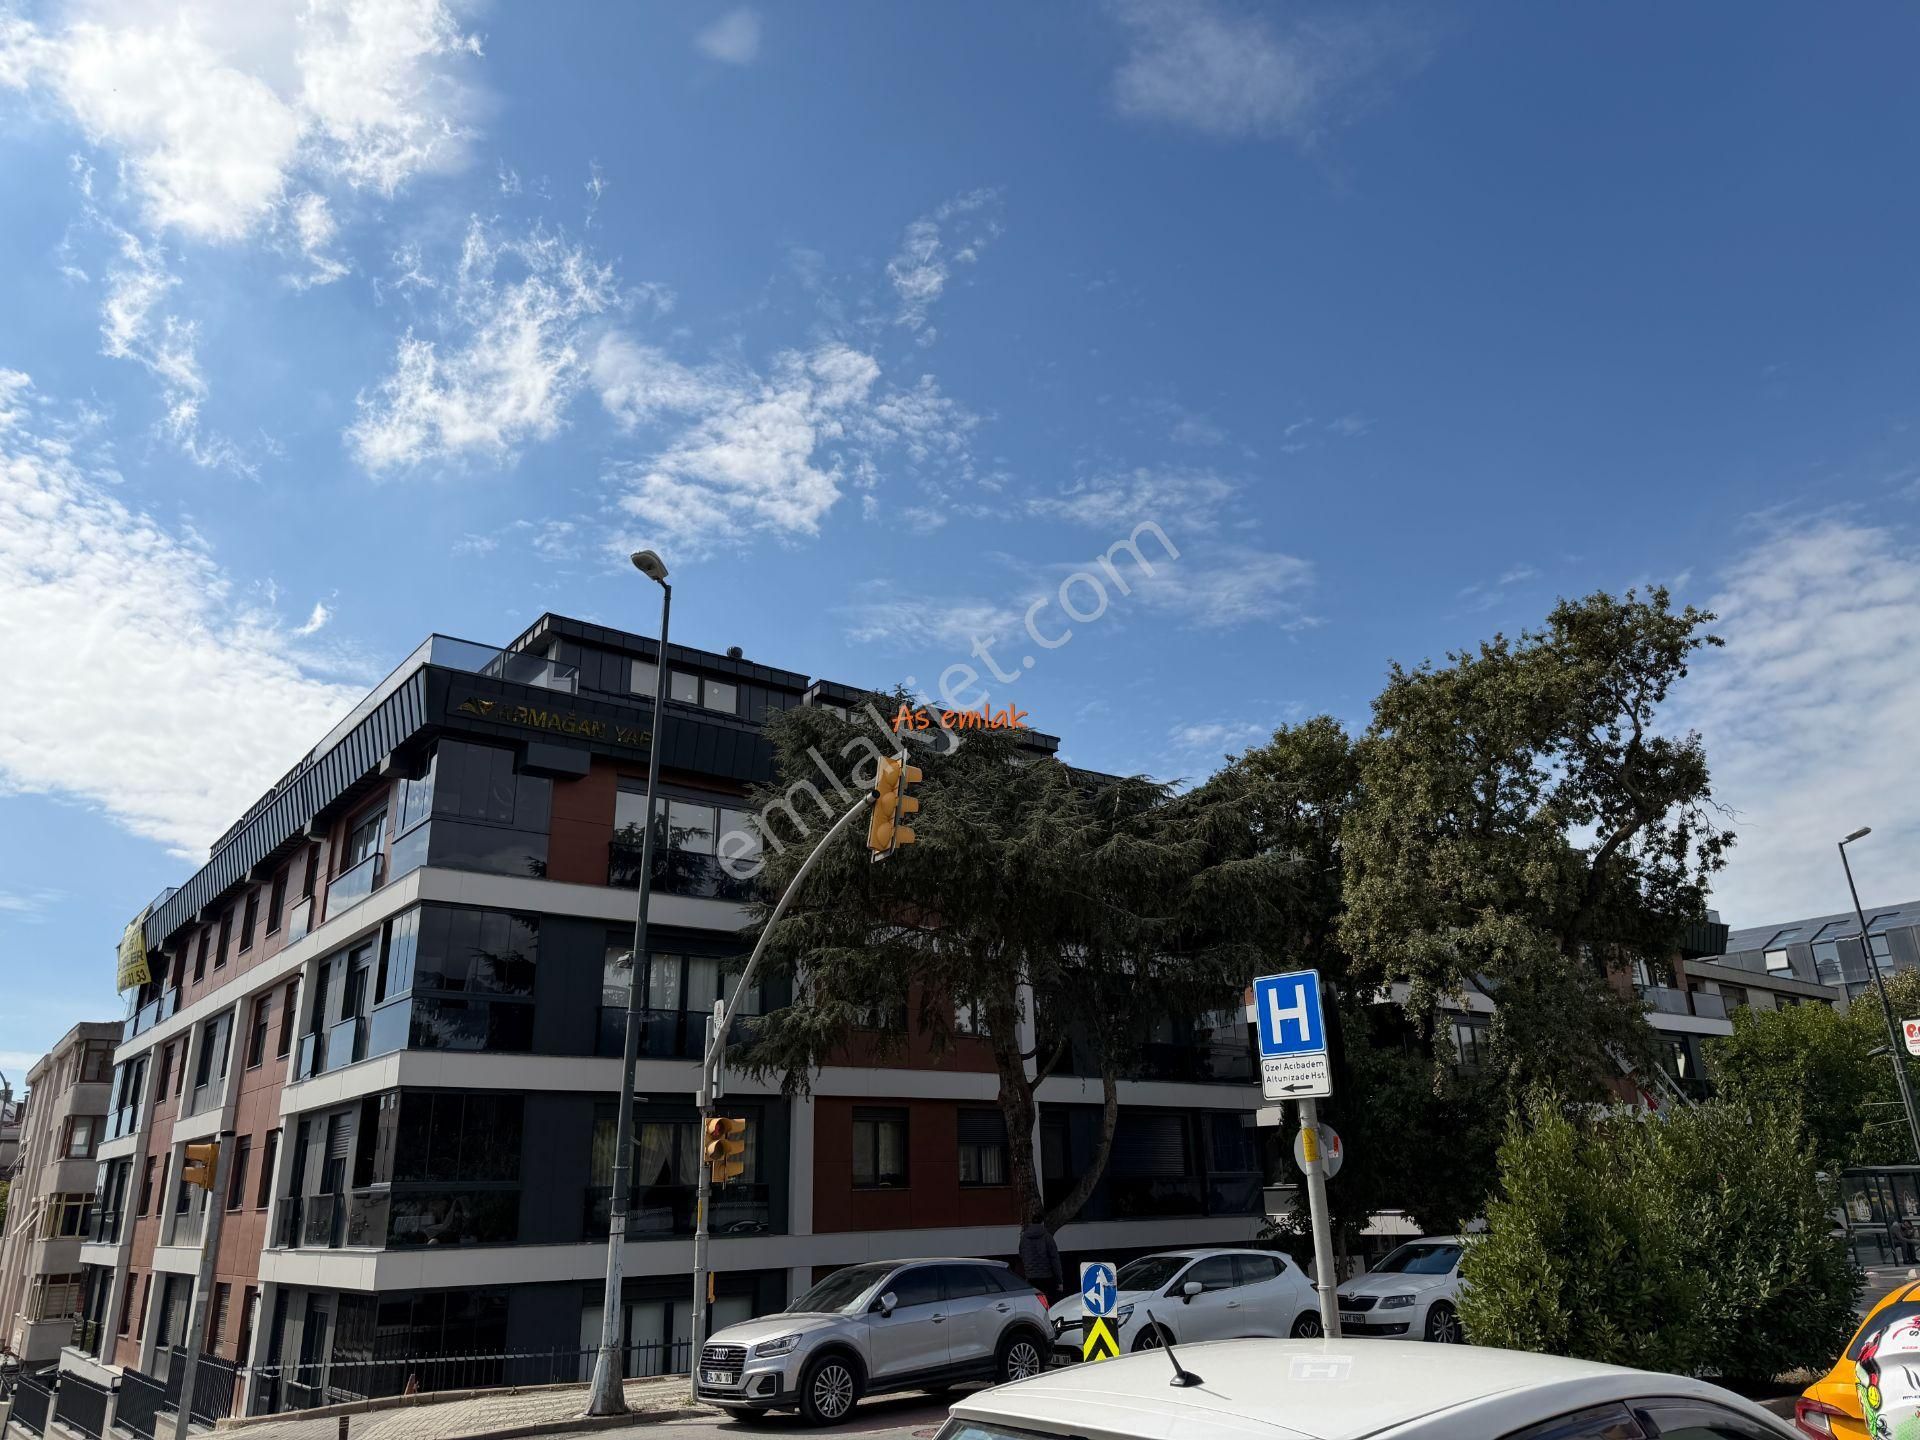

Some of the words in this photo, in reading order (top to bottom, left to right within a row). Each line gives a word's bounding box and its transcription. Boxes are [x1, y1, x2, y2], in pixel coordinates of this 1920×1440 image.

[615, 725, 653, 746] YAP
[1268, 984, 1310, 1044] H
[1264, 1062, 1281, 1071] Özel
[1284, 1061, 1324, 1070] Acıbadem
[1266, 1073, 1309, 1083] Altunizade
